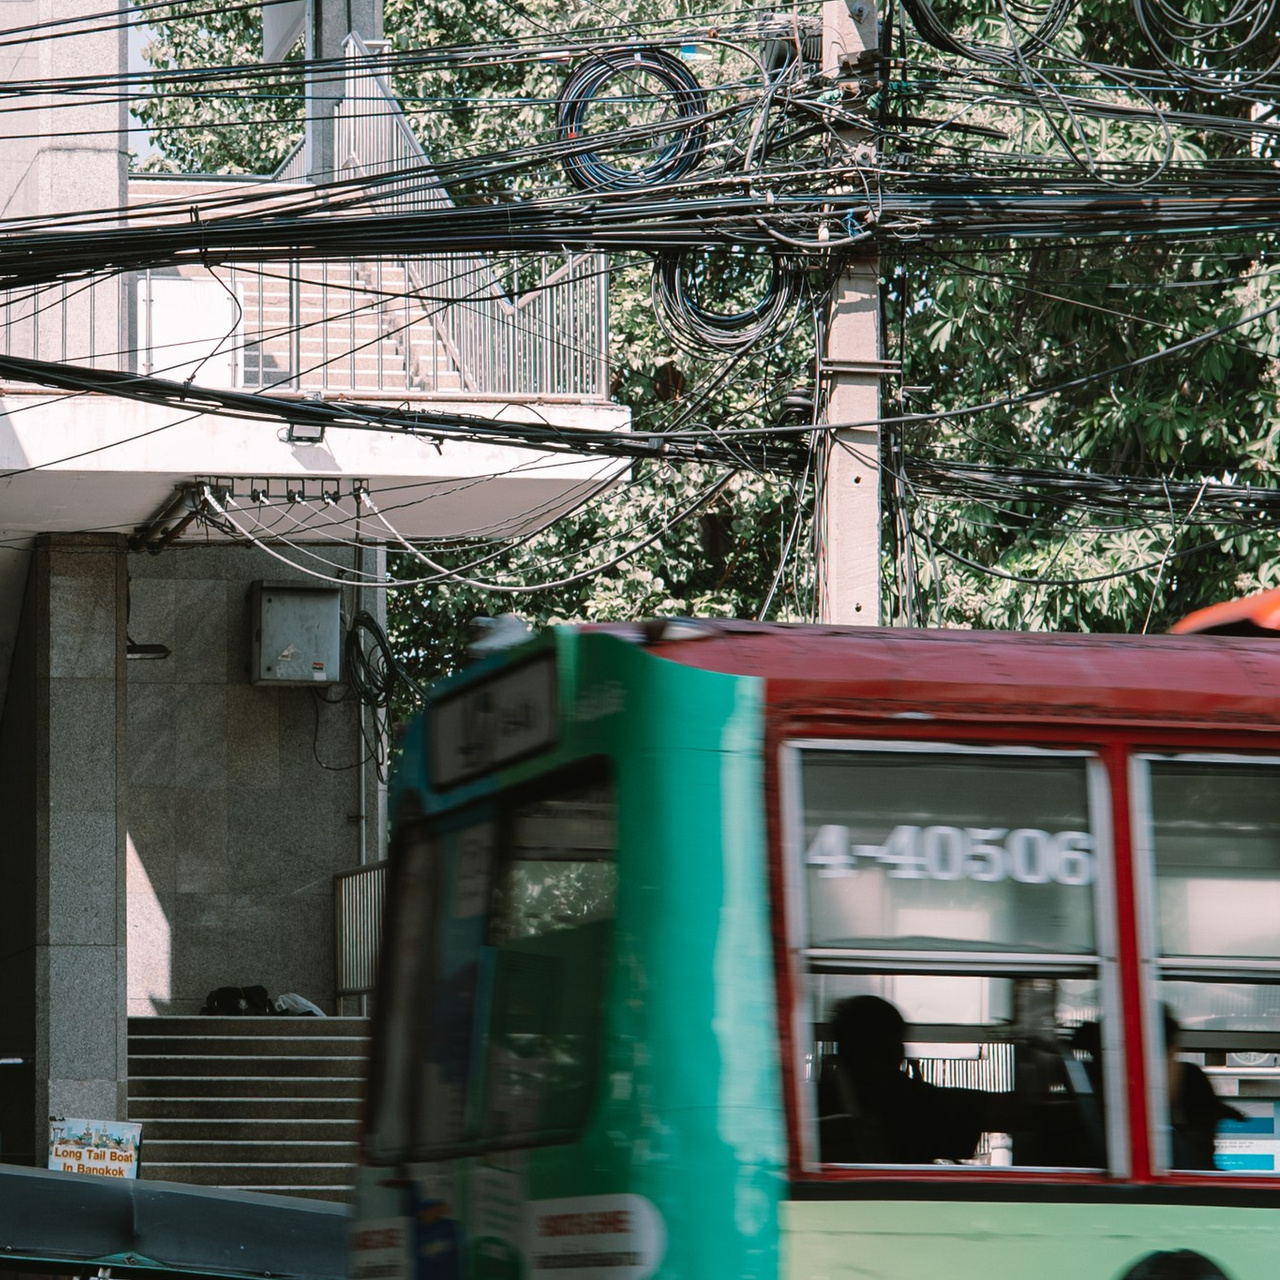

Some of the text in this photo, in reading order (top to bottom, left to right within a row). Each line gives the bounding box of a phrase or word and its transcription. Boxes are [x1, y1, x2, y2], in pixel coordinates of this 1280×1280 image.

[806, 823, 1095, 885] 4-40506
[54, 1147, 133, 1162] Long Tail Boat
[63, 1163, 125, 1176] In Bangkok
